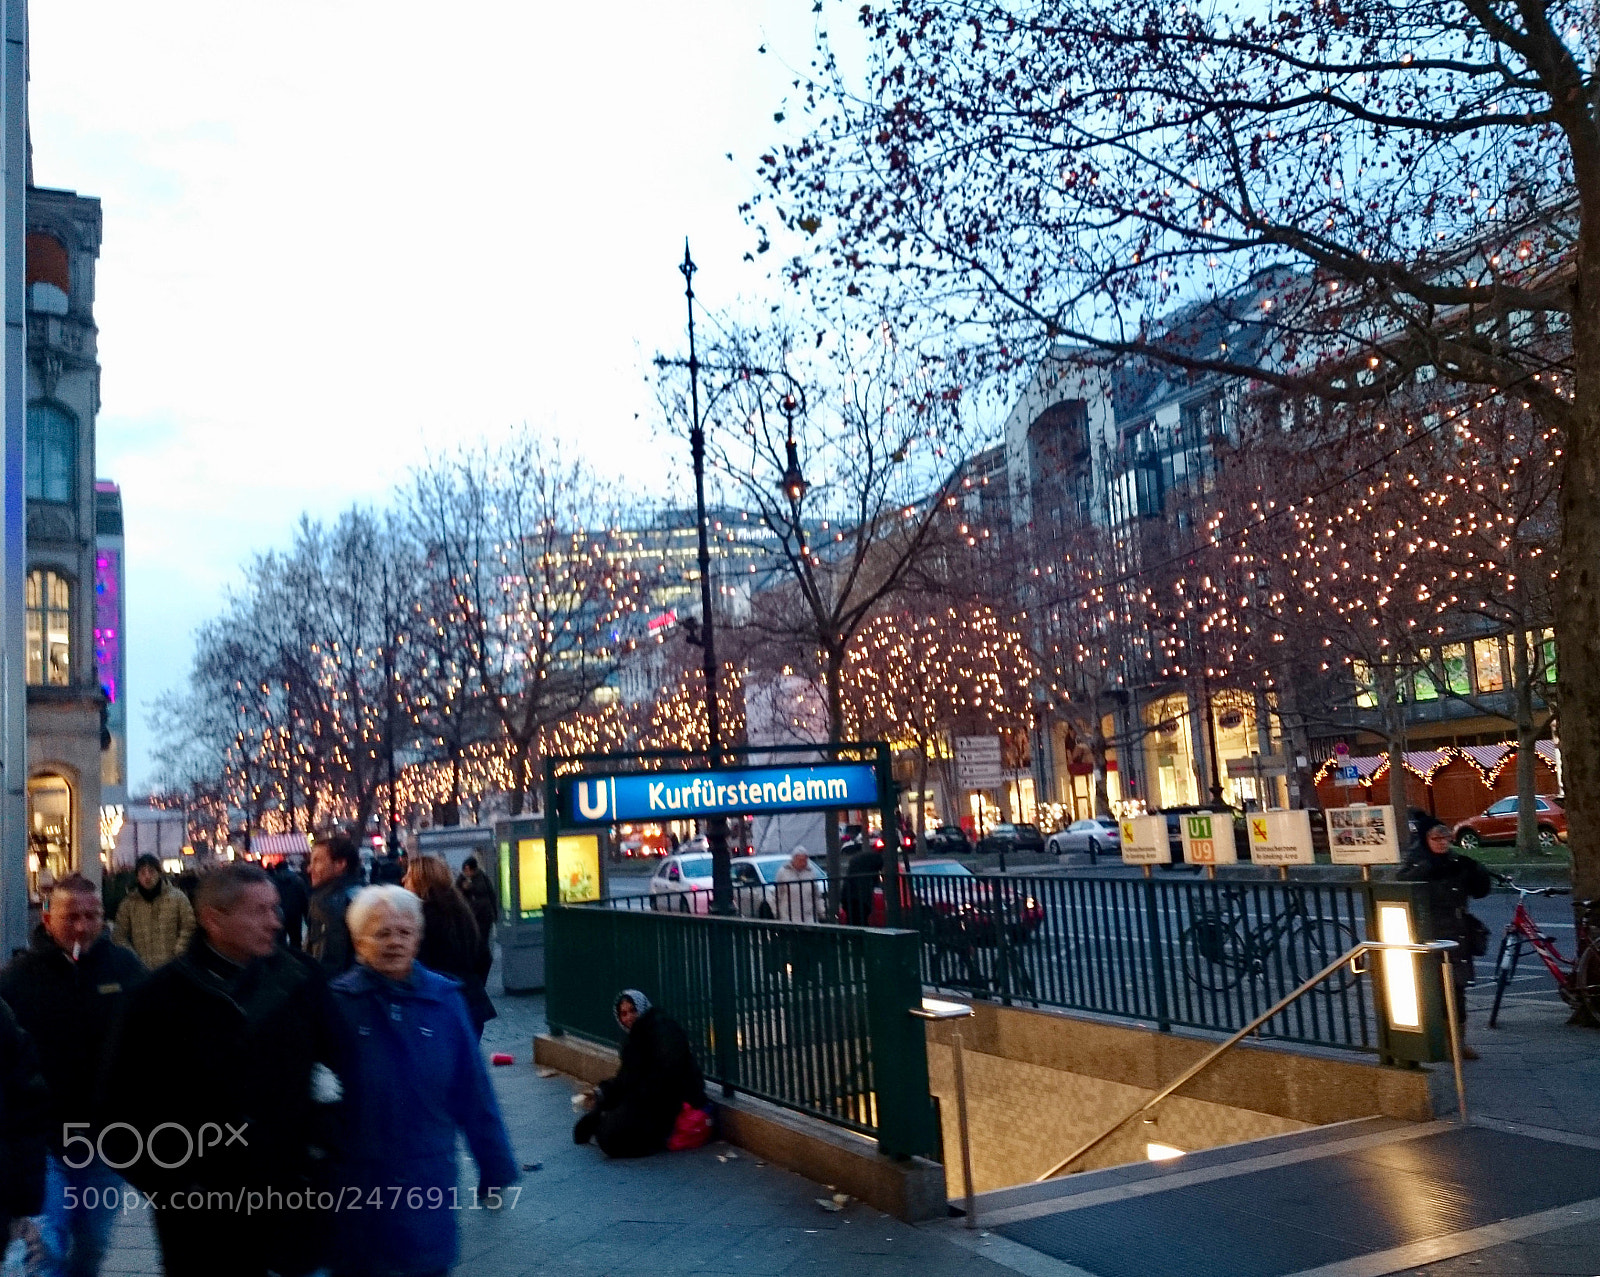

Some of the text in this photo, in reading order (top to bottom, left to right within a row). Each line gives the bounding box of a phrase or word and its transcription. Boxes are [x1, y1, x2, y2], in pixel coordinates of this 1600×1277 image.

[578, 774, 848, 819] U Kurfürstendamm
[1190, 819, 1208, 837] U1
[1192, 842, 1212, 860] U9
